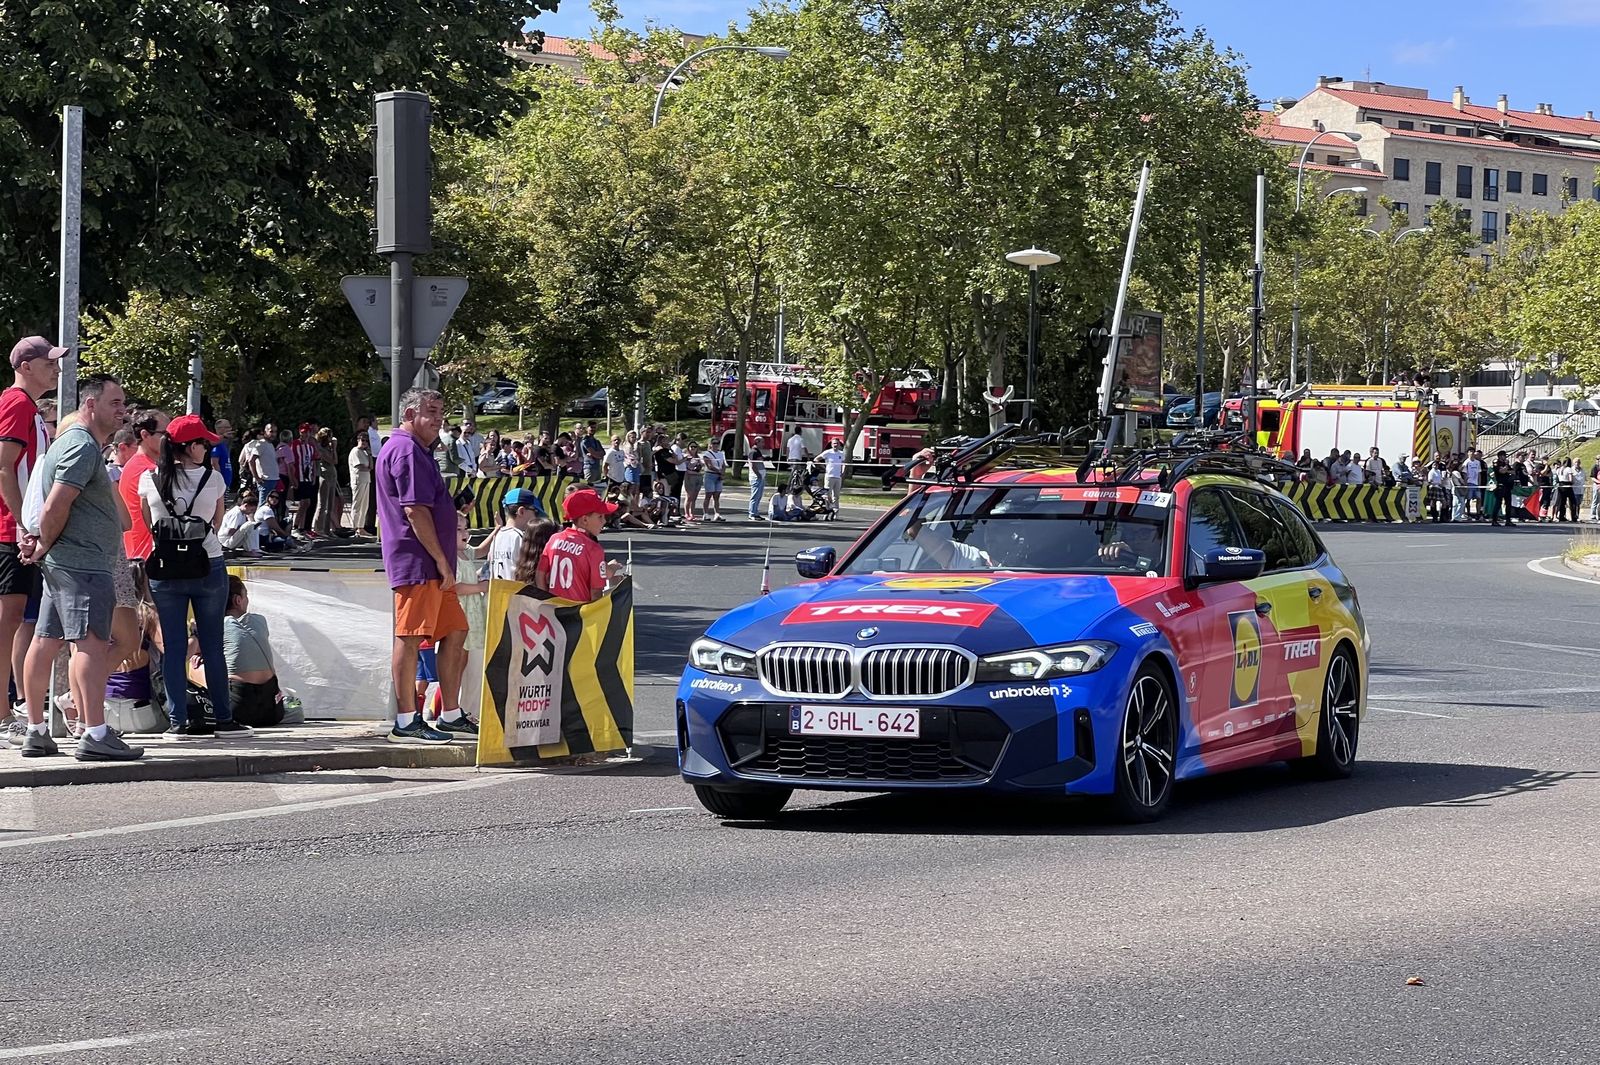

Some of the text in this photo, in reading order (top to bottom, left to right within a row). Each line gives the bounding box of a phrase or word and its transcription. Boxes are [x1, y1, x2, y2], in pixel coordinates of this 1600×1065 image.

[1083, 490, 1121, 499] EQUIPOS
[549, 554, 573, 589] 10
[810, 604, 974, 617] TREK
[1129, 622, 1158, 637] PIRELLI
[1284, 640, 1317, 660] TREK
[519, 685, 551, 698] WÜRTH
[690, 678, 733, 693] unbroken
[989, 685, 1059, 699] unbroken
[517, 699, 550, 712] MODYF
[516, 719, 549, 729] WORKWEAR
[792, 721, 799, 730] B
